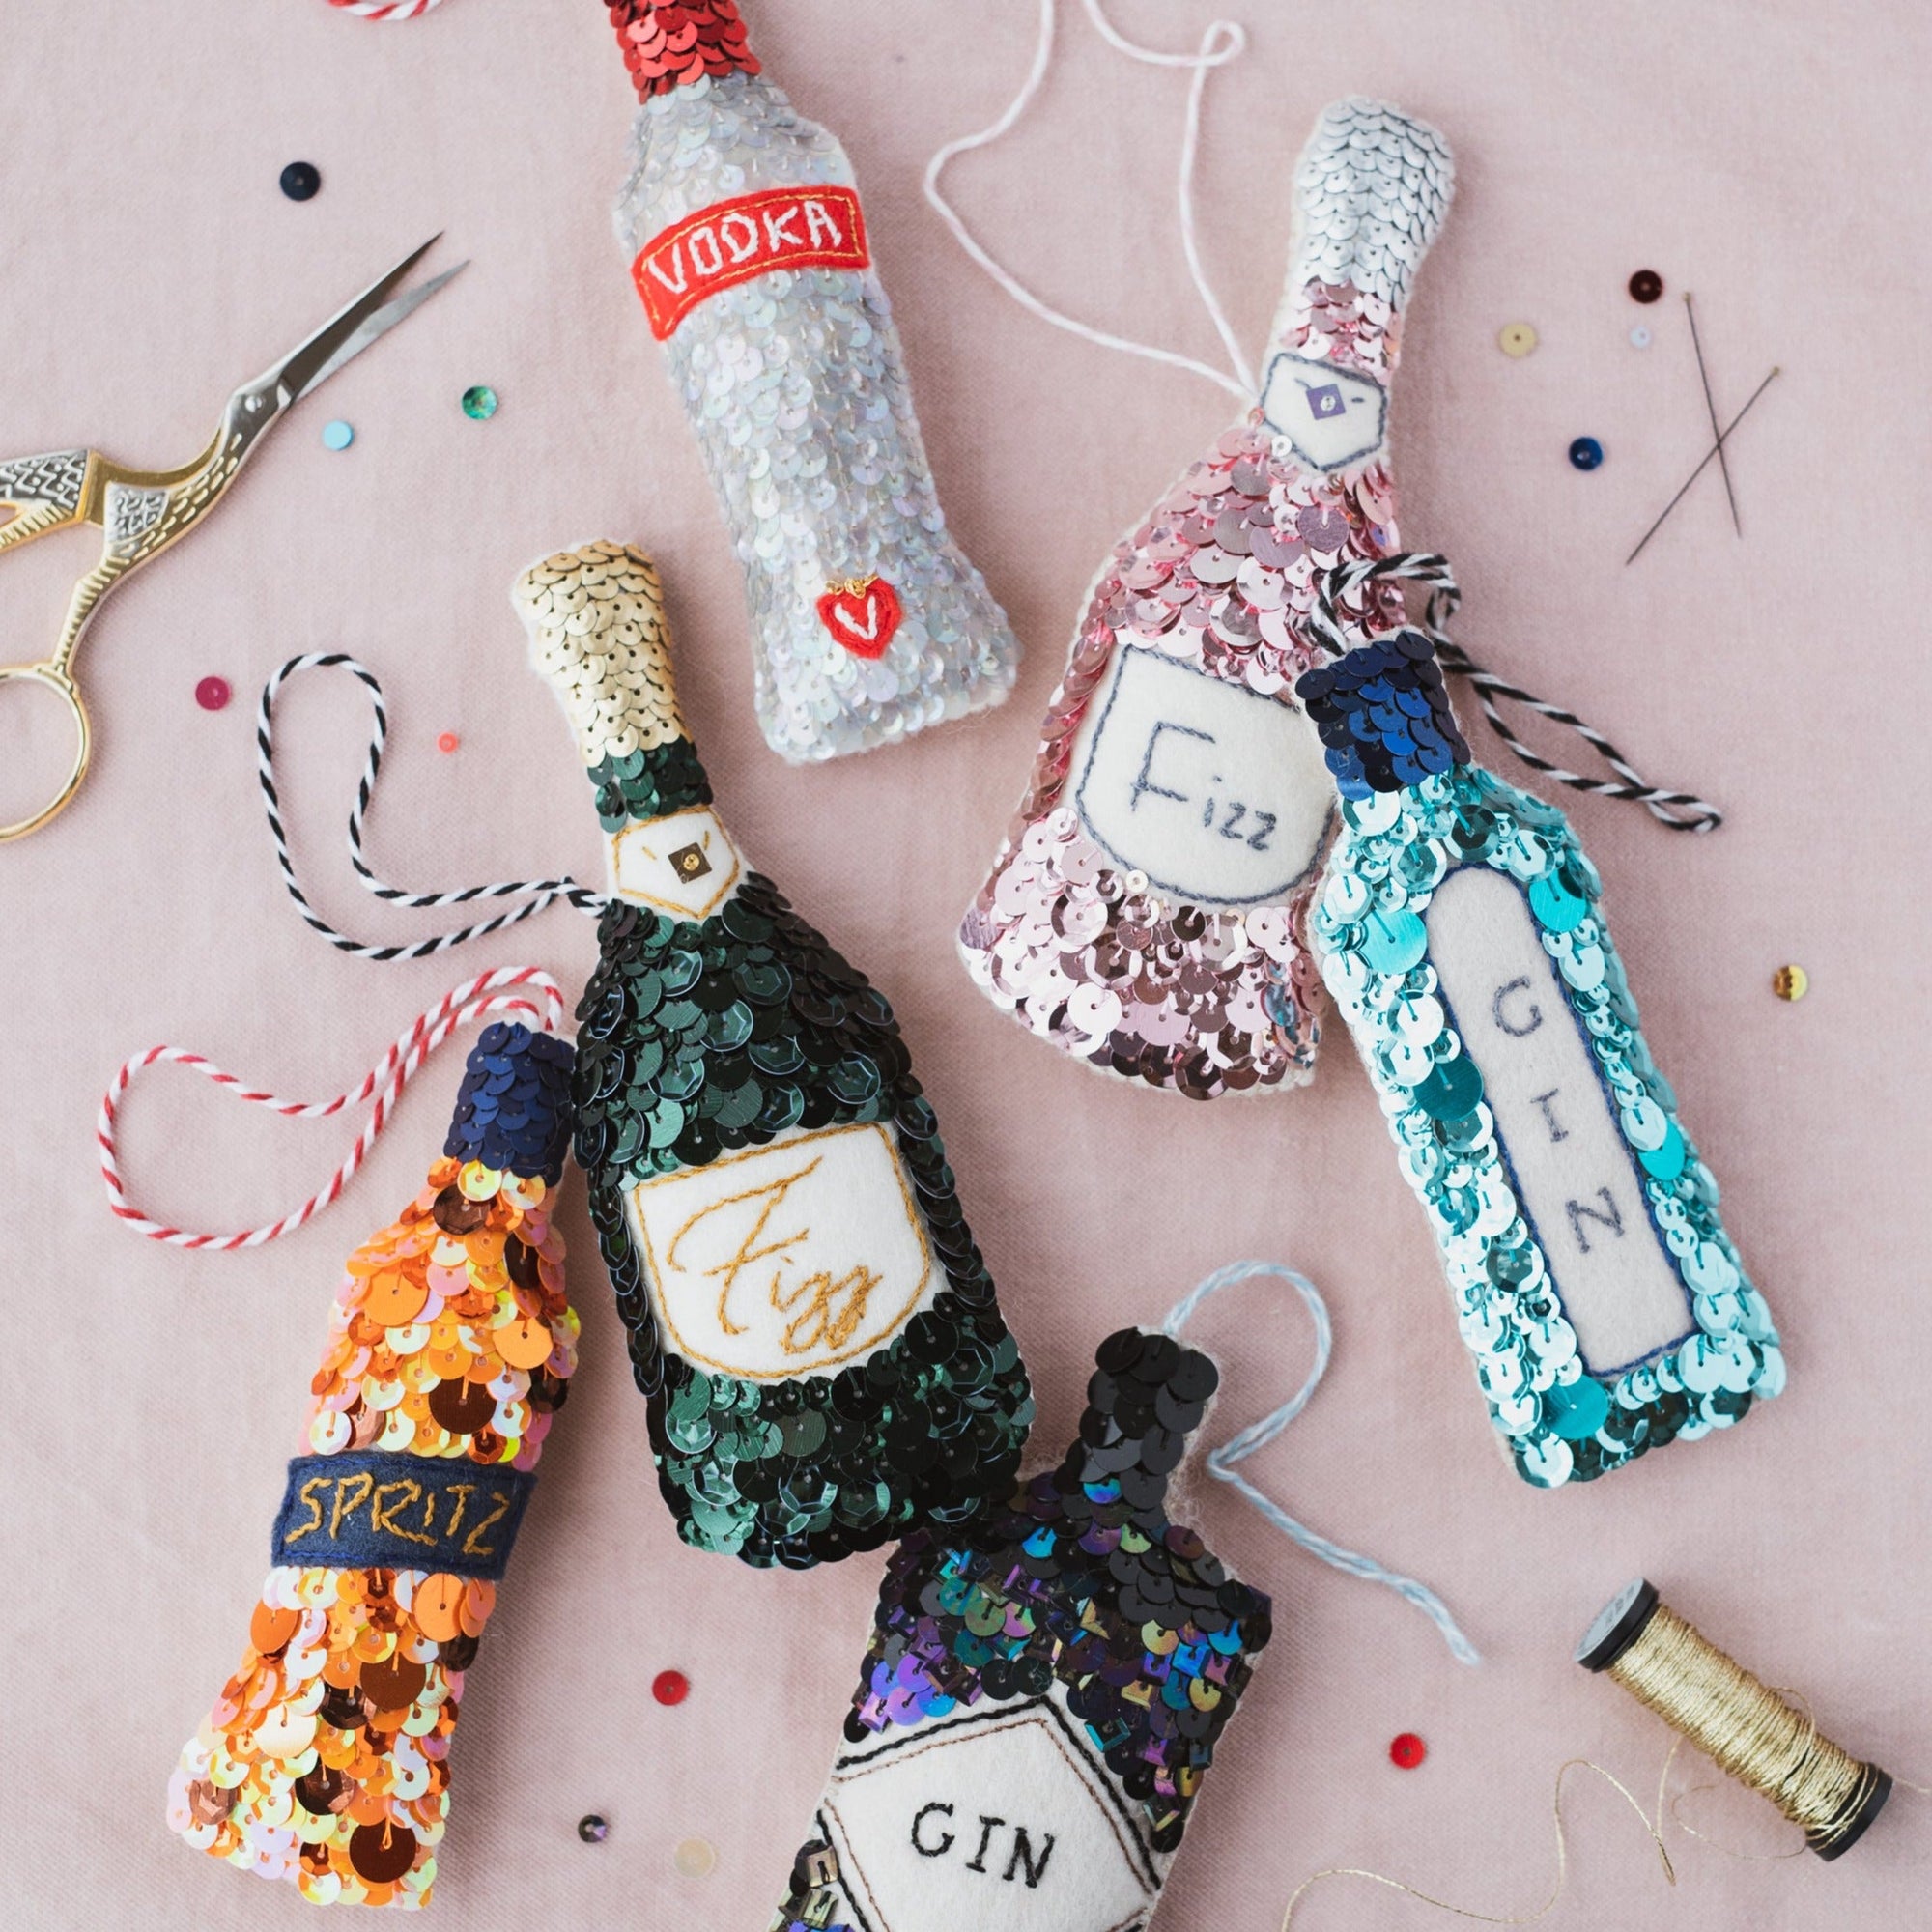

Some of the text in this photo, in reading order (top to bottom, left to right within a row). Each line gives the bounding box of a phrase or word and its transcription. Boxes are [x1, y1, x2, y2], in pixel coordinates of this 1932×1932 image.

[647, 200, 842, 294] VODKA
[834, 594, 878, 640] V
[1130, 721, 1277, 851] Fizz
[1492, 975, 1626, 1254] GIN
[667, 1154, 884, 1355] Fizz
[284, 1471, 510, 1555] SPRITZ
[911, 1802, 1056, 1889] GIN
